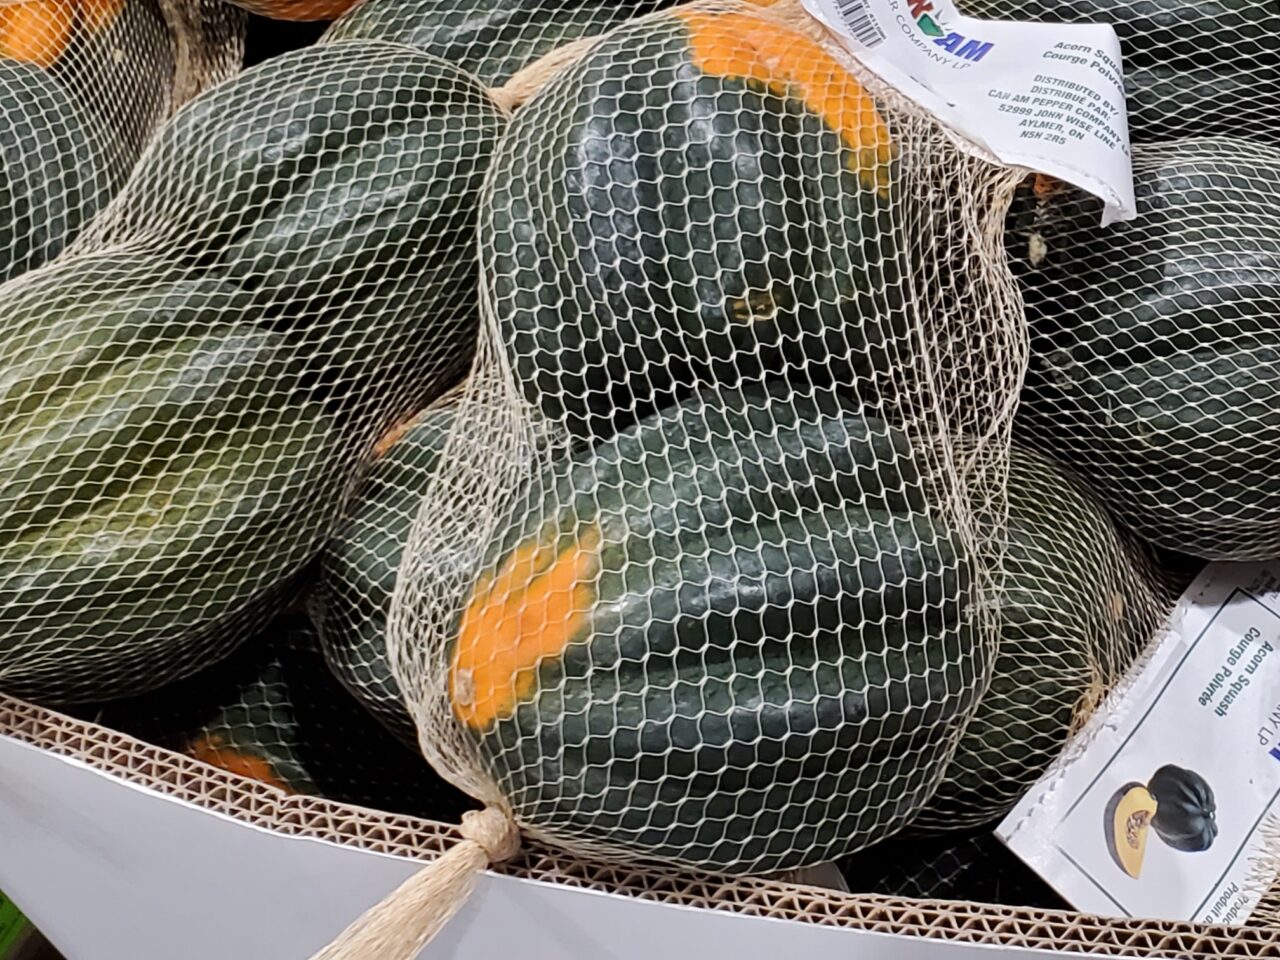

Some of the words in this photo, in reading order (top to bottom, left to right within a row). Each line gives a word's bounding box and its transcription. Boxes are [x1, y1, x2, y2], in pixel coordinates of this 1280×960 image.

[895, 14, 953, 65] COMPANY
[951, 61, 972, 70] LP
[932, 32, 995, 62] AM
[1042, 50, 1088, 65] Courge
[1053, 41, 1092, 54] Acorn
[1030, 85, 1087, 105] DISTRIBUÉ
[1087, 101, 1112, 122] PAR:
[1033, 74, 1102, 102] DISTRIBUTED
[1102, 100, 1120, 117] BY/
[987, 89, 1012, 101] CAN
[1012, 94, 1030, 104] AM
[1031, 97, 1074, 112] PEPPER
[1074, 107, 1123, 144] COMPANY
[998, 103, 1034, 116] 52999
[1034, 108, 1064, 121] JOHN
[1065, 114, 1094, 133] WISE
[1094, 129, 1116, 150] LINE
[1018, 119, 1065, 135] AYLMER,
[1068, 129, 1086, 141] ON
[1044, 133, 1067, 146] 2R5
[1226, 626, 1261, 667] Courge
[1244, 640, 1275, 675] Acorn
[1197, 668, 1233, 707] Poivrée
[1213, 674, 1251, 718] Squash
[1256, 728, 1275, 747] LP
[1211, 881, 1240, 919] Produit
